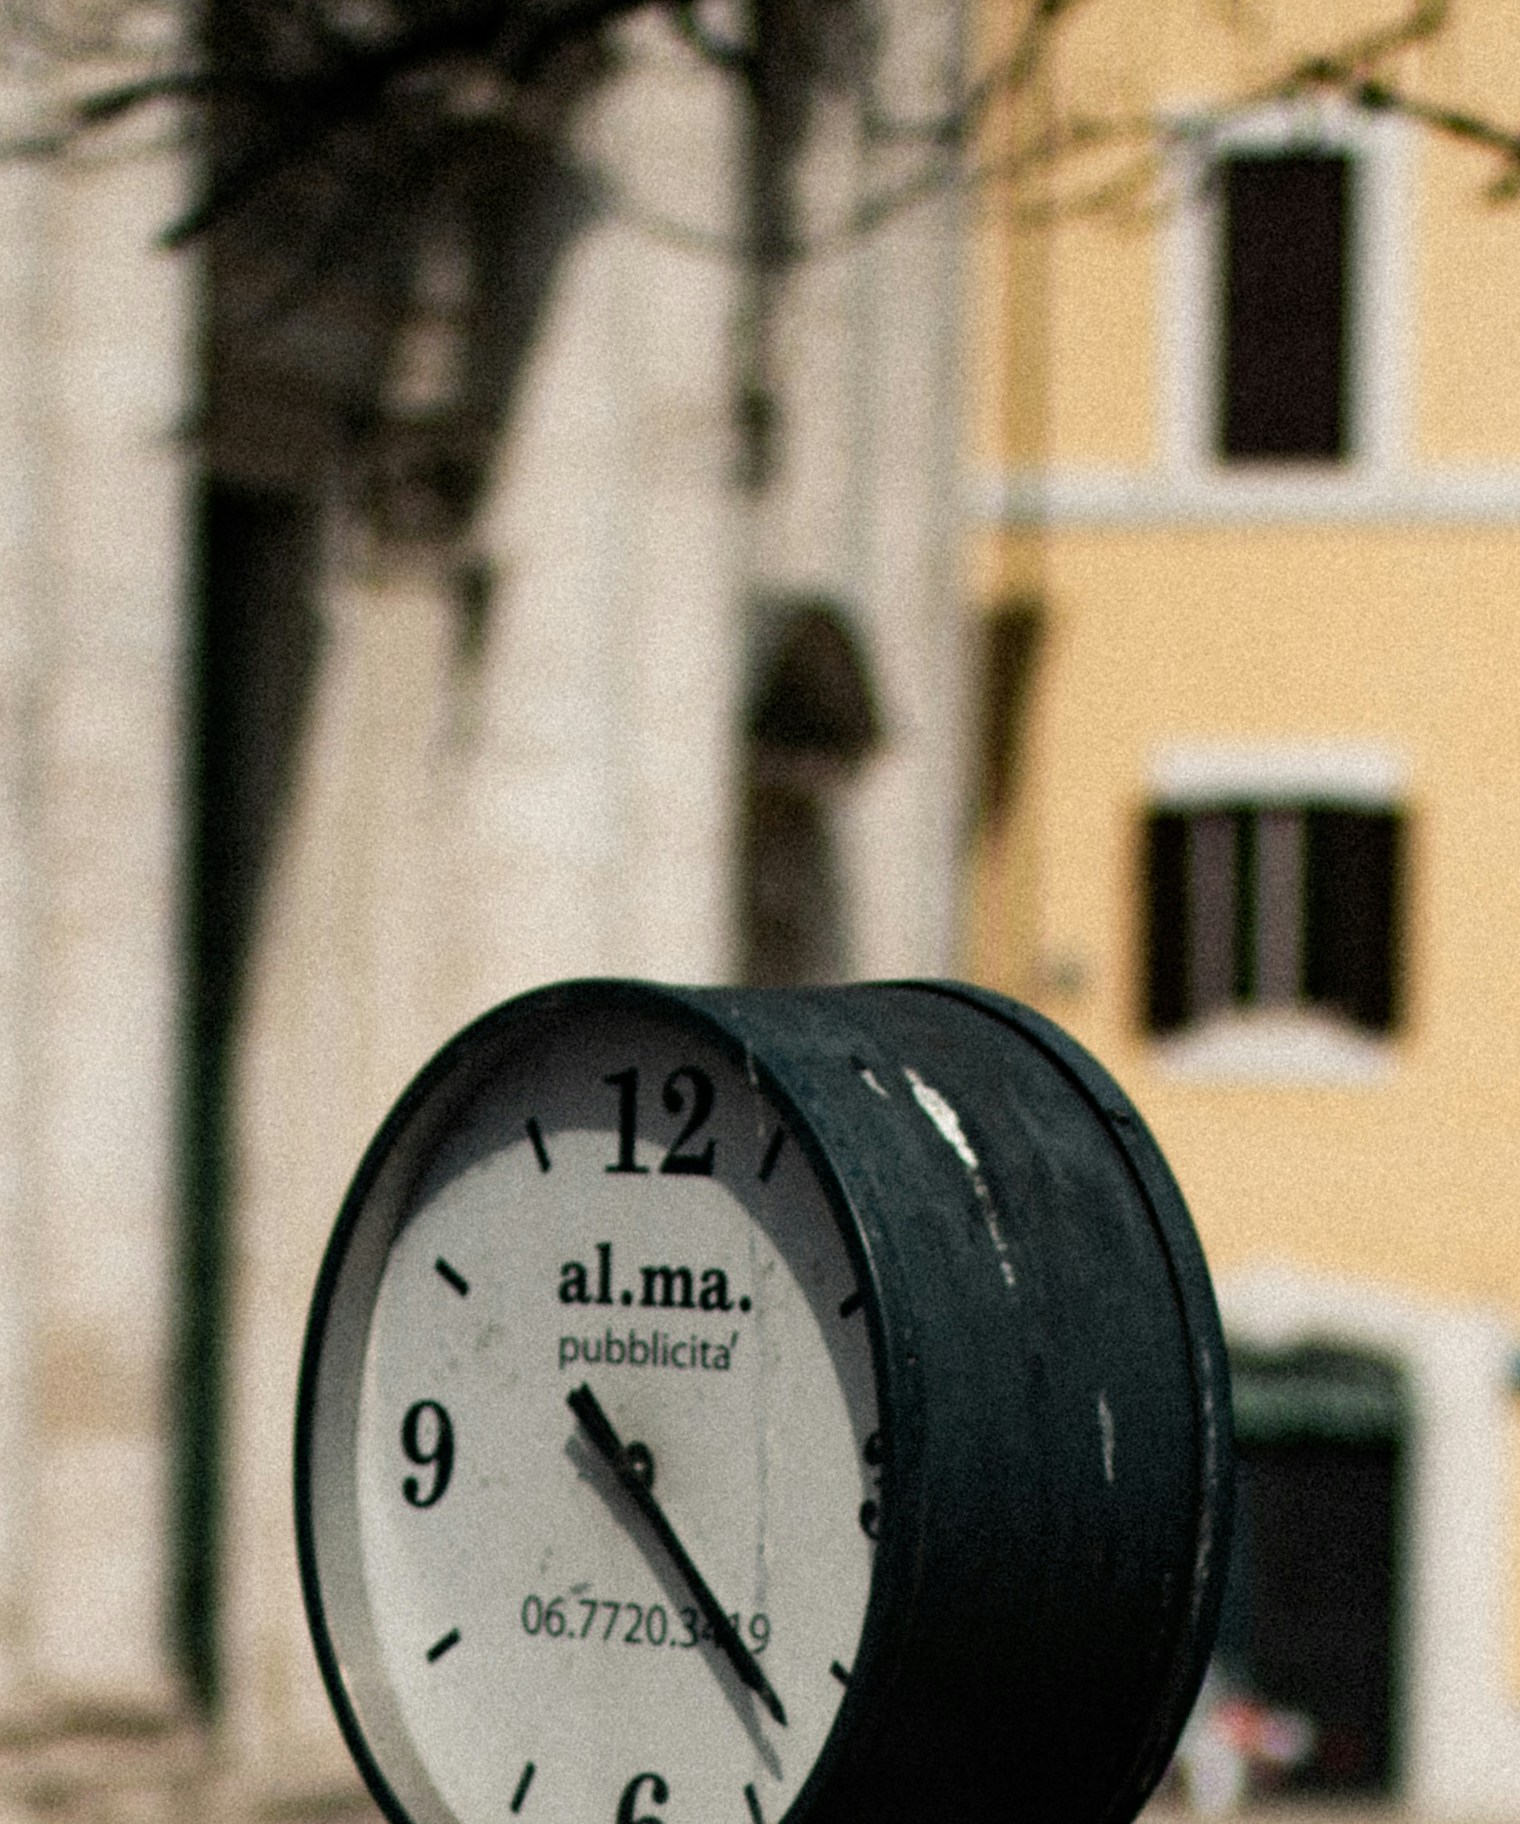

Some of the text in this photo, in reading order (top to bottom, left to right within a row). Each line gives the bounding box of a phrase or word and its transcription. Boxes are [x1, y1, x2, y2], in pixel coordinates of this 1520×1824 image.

[604, 1066, 716, 1175] 12
[558, 1241, 753, 1313] al.ma.
[401, 1399, 455, 1509] 9
